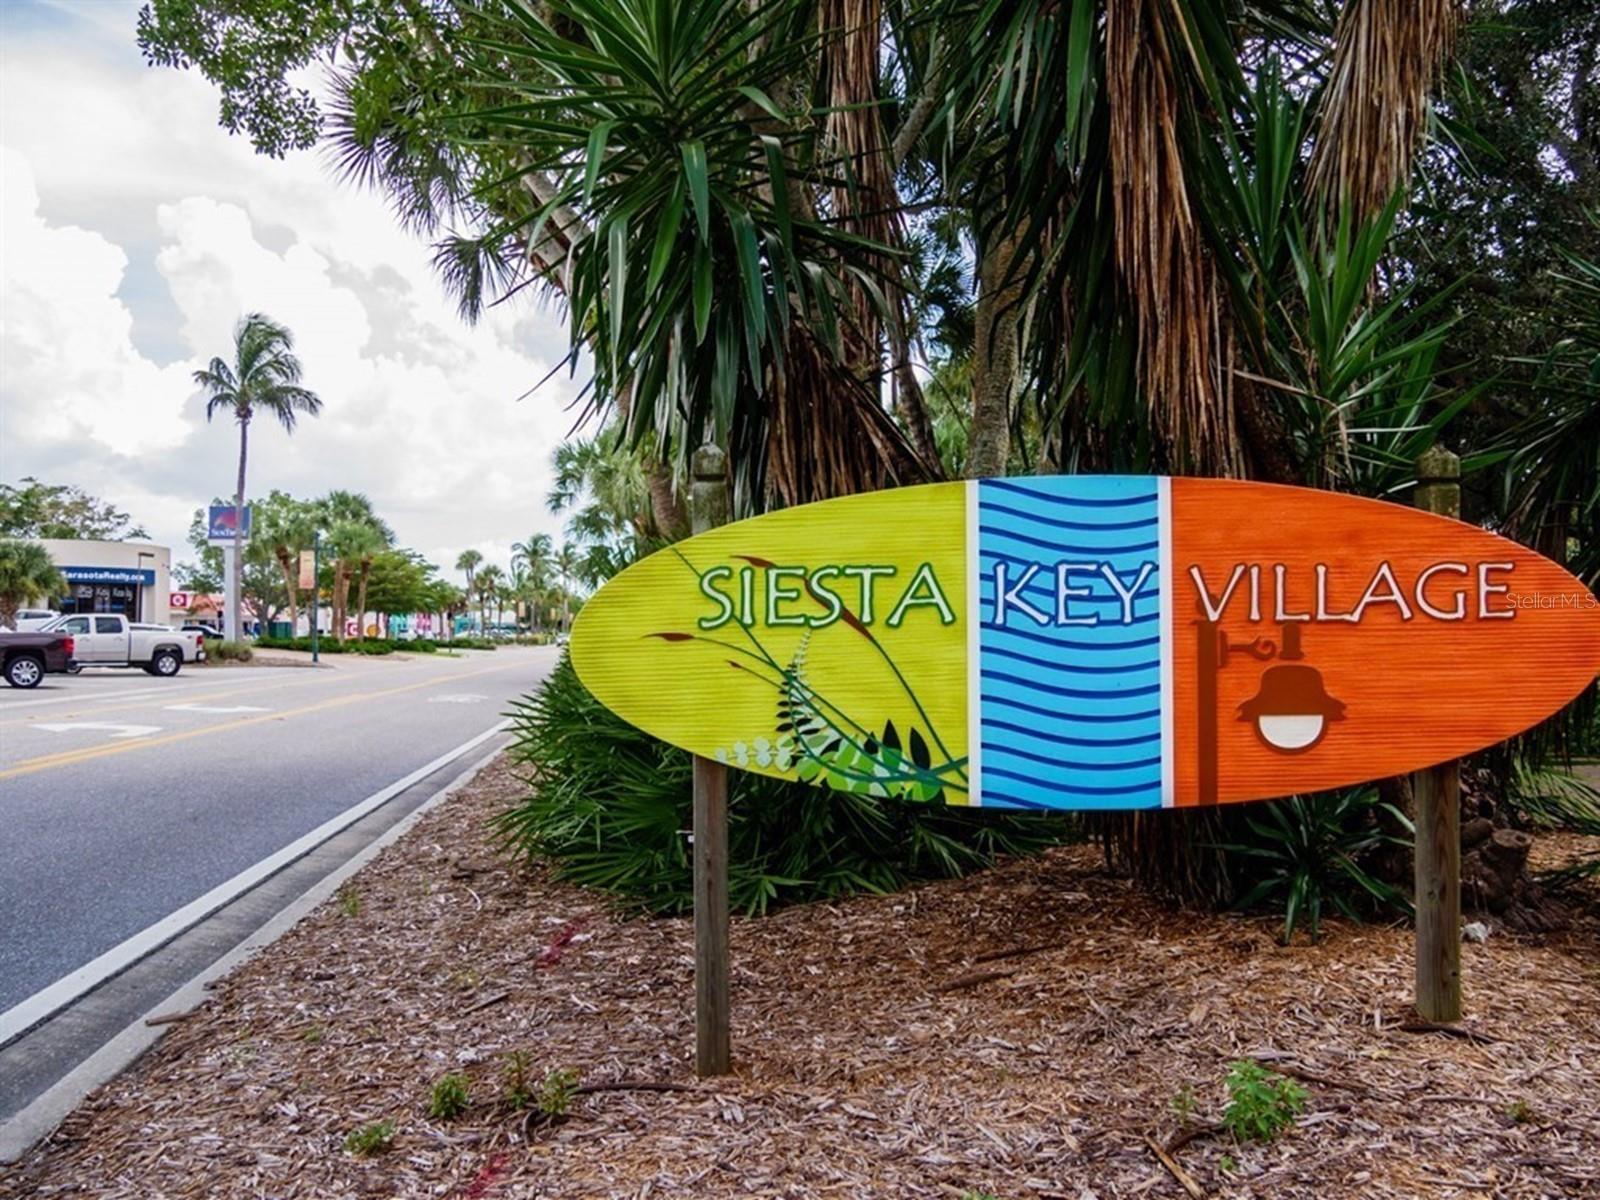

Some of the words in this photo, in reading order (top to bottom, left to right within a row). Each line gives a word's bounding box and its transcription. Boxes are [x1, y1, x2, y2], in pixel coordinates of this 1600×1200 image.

[699, 562, 956, 629] SIESTA
[993, 560, 1156, 627] KEY
[1189, 560, 1516, 623] VILLAGE
